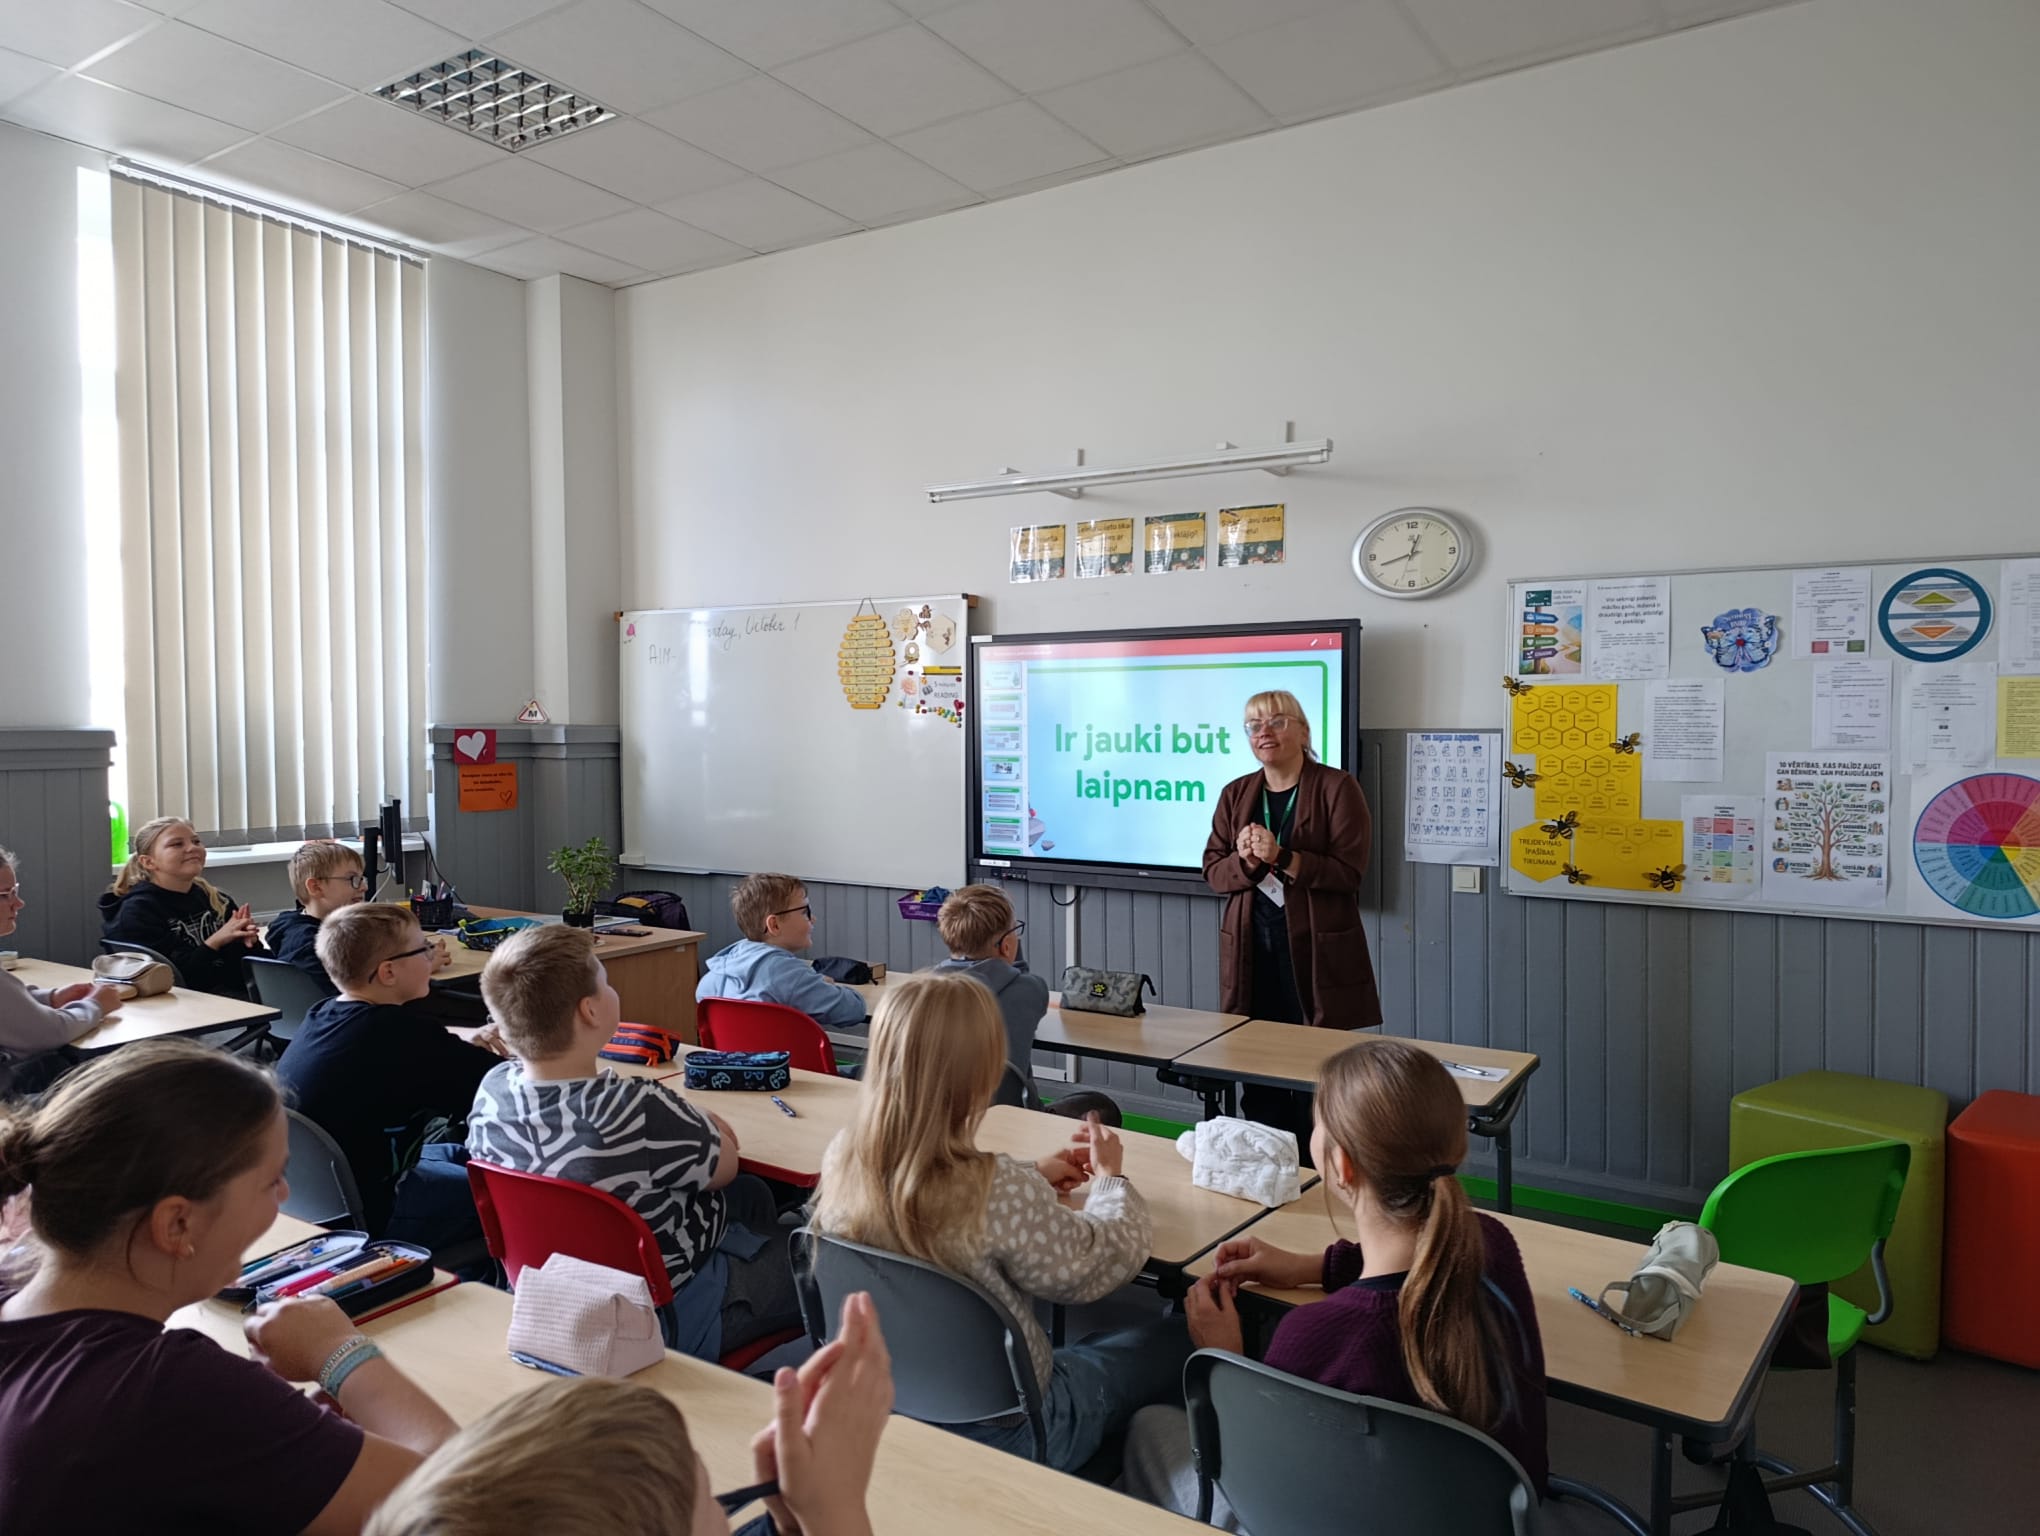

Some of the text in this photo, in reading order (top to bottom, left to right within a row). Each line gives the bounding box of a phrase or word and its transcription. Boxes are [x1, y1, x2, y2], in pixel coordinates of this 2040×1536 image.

[528, 710, 538, 718] M
[1056, 722, 1231, 761] Ir jauki būt
[1076, 769, 1206, 807] laipnam
